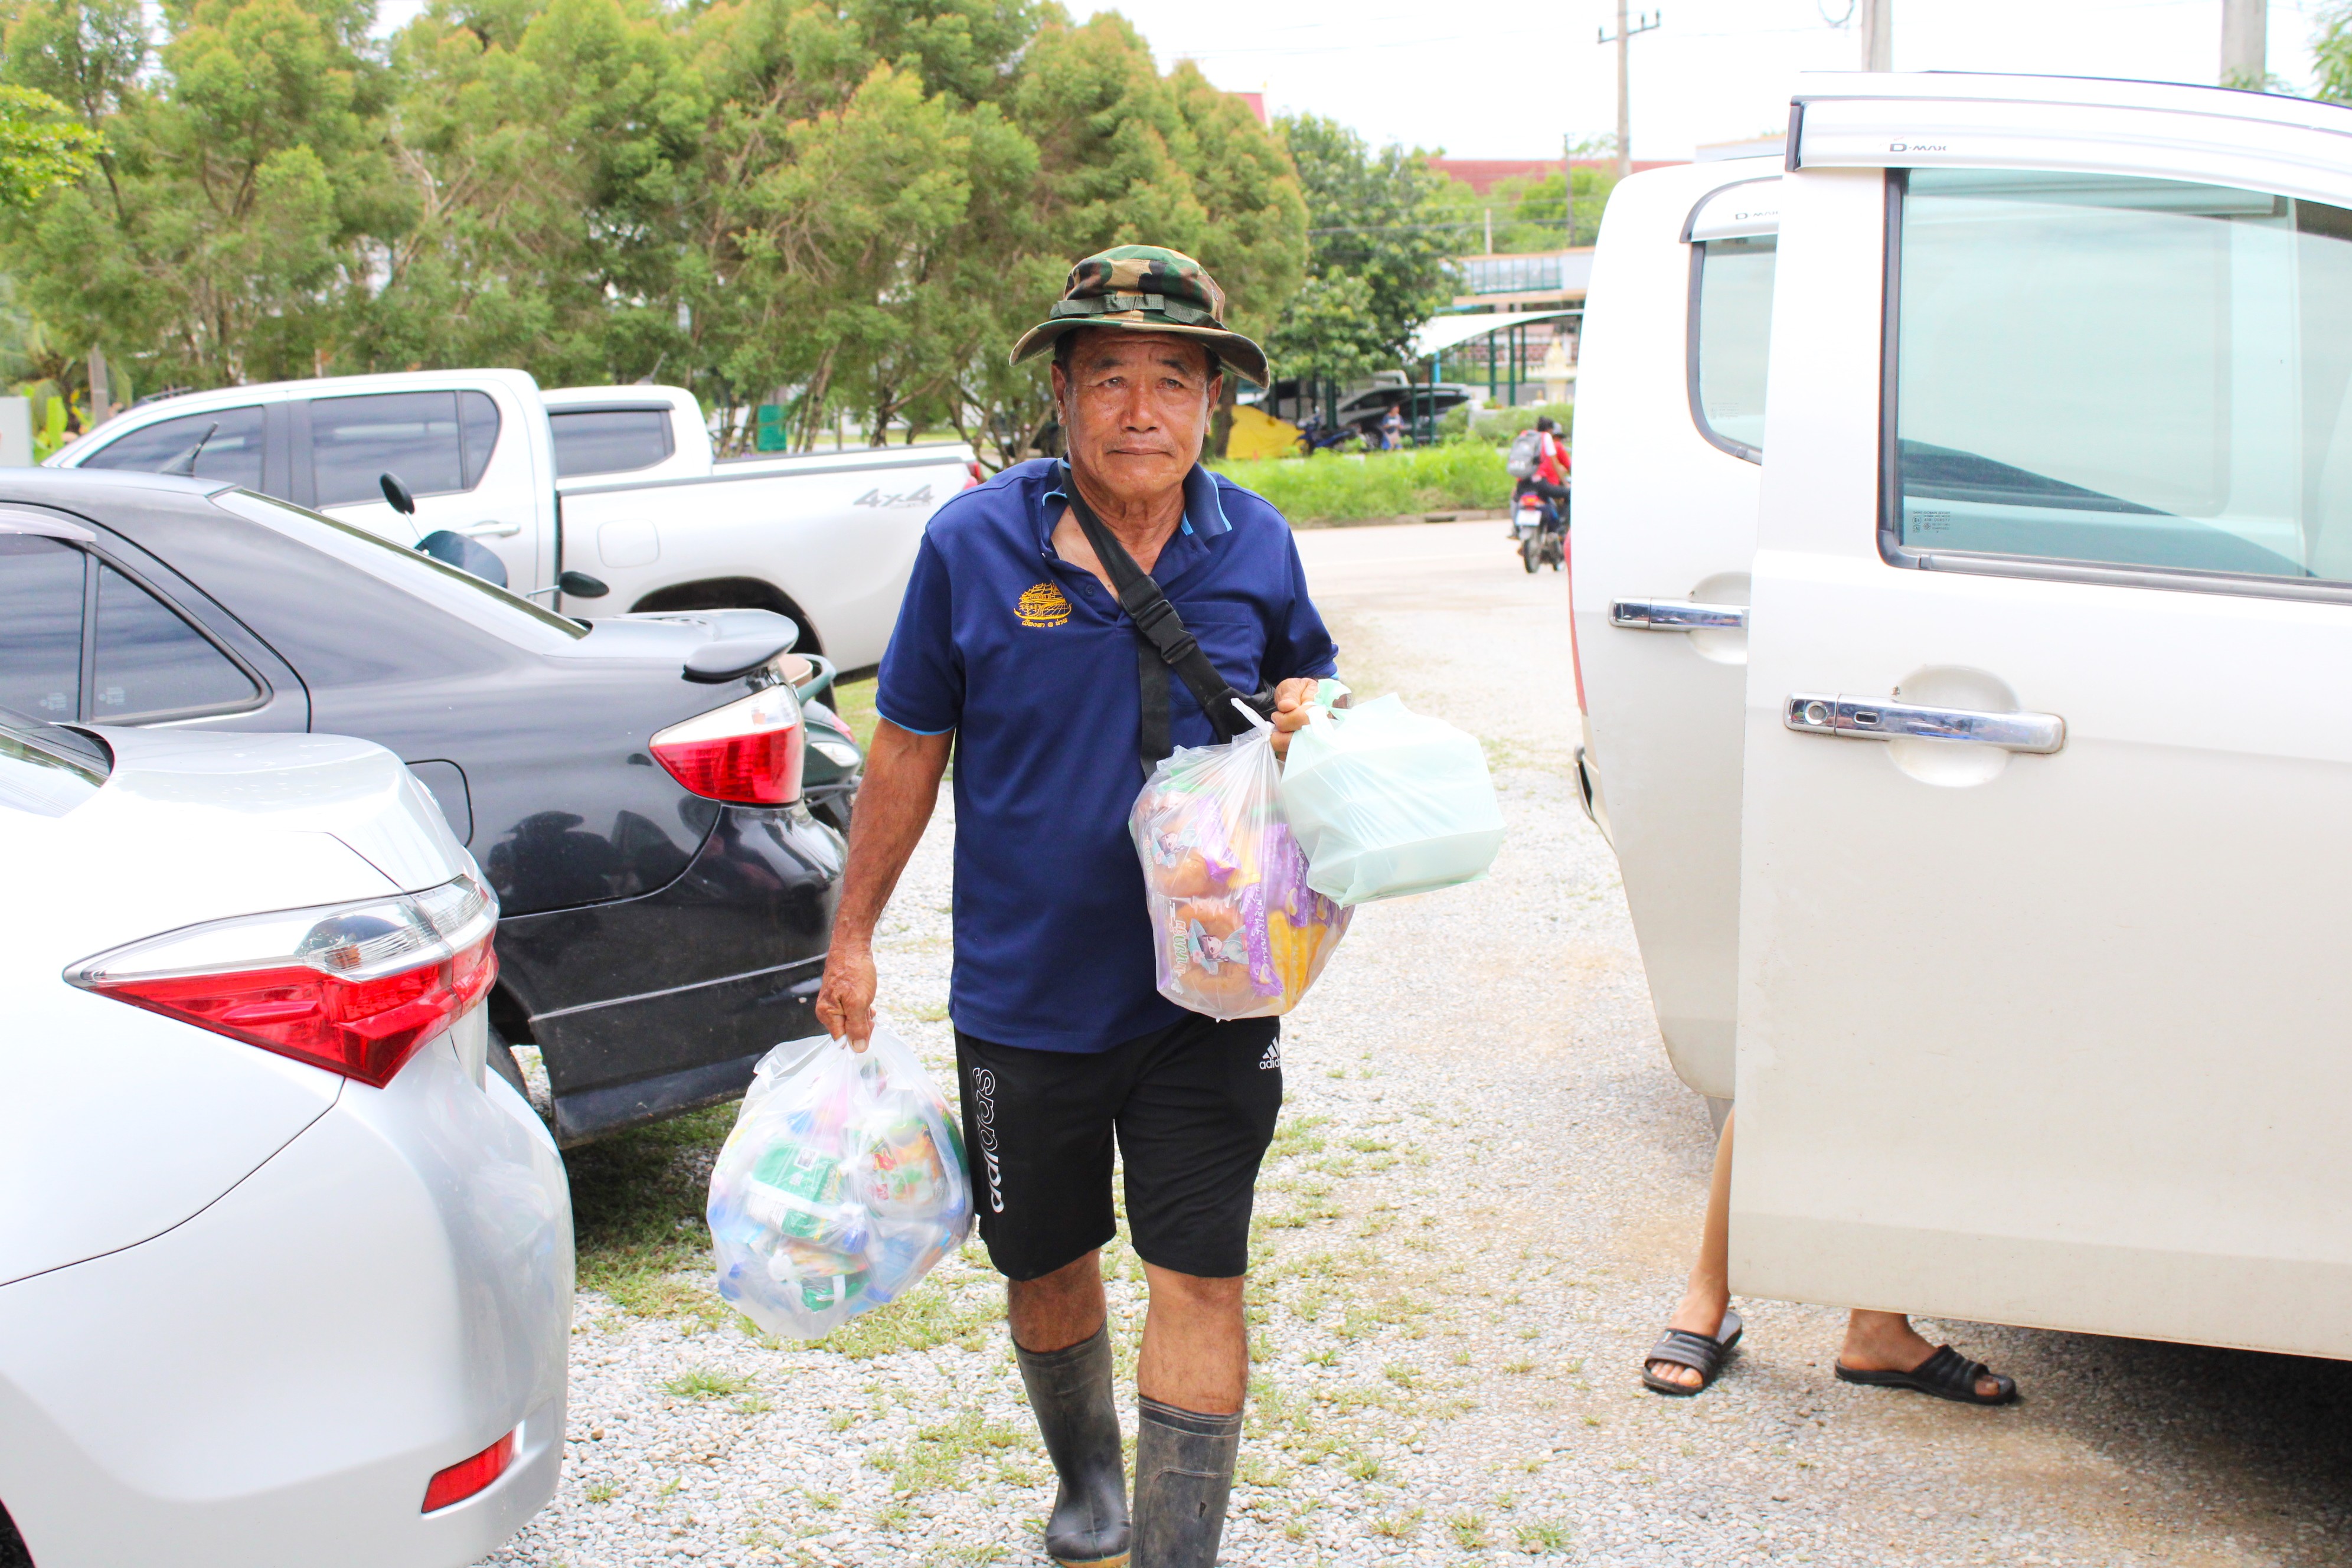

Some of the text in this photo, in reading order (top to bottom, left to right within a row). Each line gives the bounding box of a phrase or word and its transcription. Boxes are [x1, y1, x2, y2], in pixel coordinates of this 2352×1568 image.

[1890, 143, 1946, 152] D-MAX
[852, 484, 935, 507] 4x4
[973, 1067, 1004, 1213] adidas
